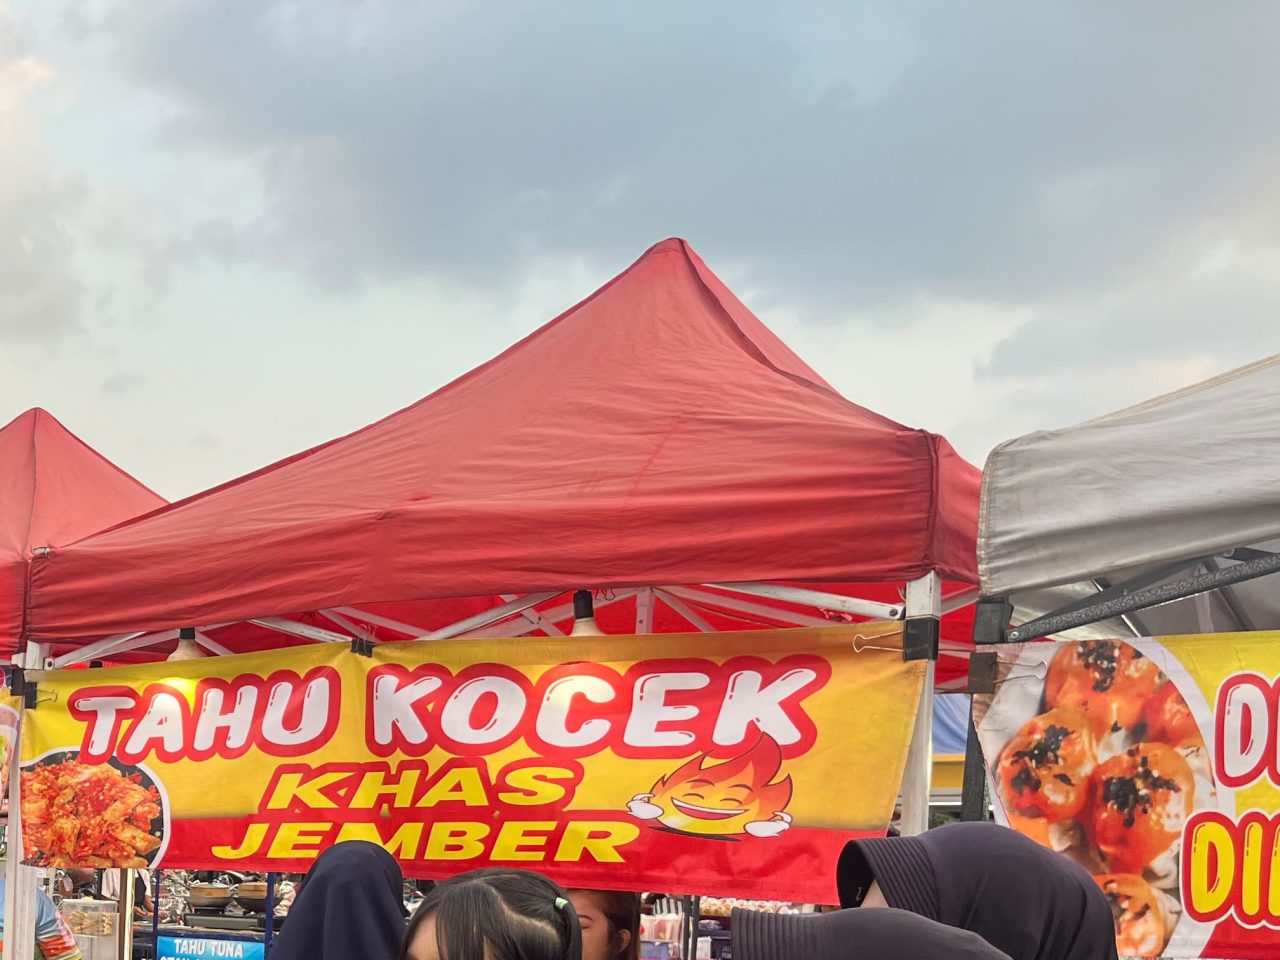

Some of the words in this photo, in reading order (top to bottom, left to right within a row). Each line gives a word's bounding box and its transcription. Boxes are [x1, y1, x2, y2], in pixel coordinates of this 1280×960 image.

[74, 676, 330, 756] TAHU
[372, 667, 817, 748] KOCEK
[1223, 683, 1280, 778] D
[266, 765, 576, 811] KHAS
[210, 821, 641, 863] JEMBER
[174, 938, 206, 955] TAHU
[210, 940, 244, 958] TUNA
